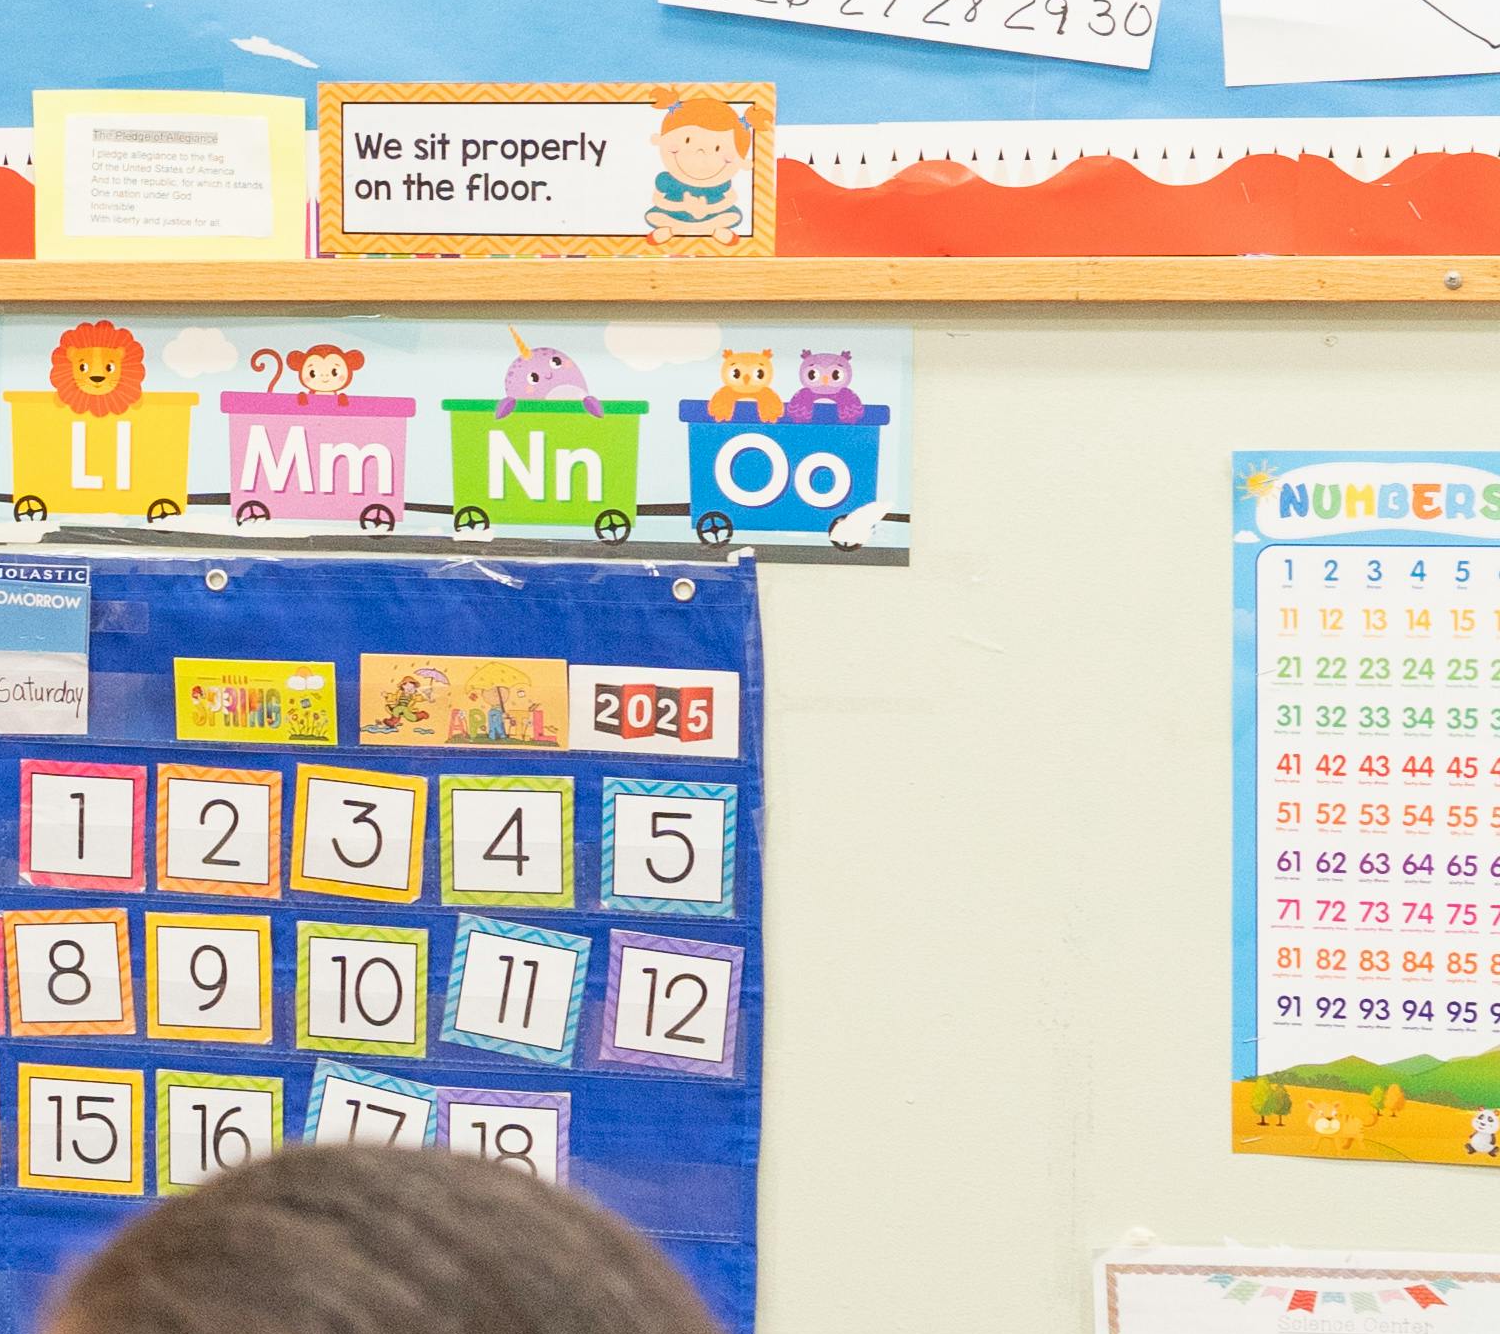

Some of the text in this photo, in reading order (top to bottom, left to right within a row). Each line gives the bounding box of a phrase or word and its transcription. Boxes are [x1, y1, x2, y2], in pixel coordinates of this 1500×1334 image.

[1089, 0, 1152, 36] 30
[93, 130, 218, 144] The Pledge of Allegiance
[354, 132, 607, 167] We sit properly
[180, 152, 189, 160] to
[191, 153, 205, 161] the
[355, 173, 552, 201] on the floor.
[71, 420, 131, 490] Ll
[240, 423, 394, 497] Mm
[489, 429, 604, 502] Nn
[714, 433, 852, 507] Oo
[1279, 483, 1500, 520] NUMBERS
[191, 685, 283, 729] SPRING
[596, 691, 709, 735] 2025
